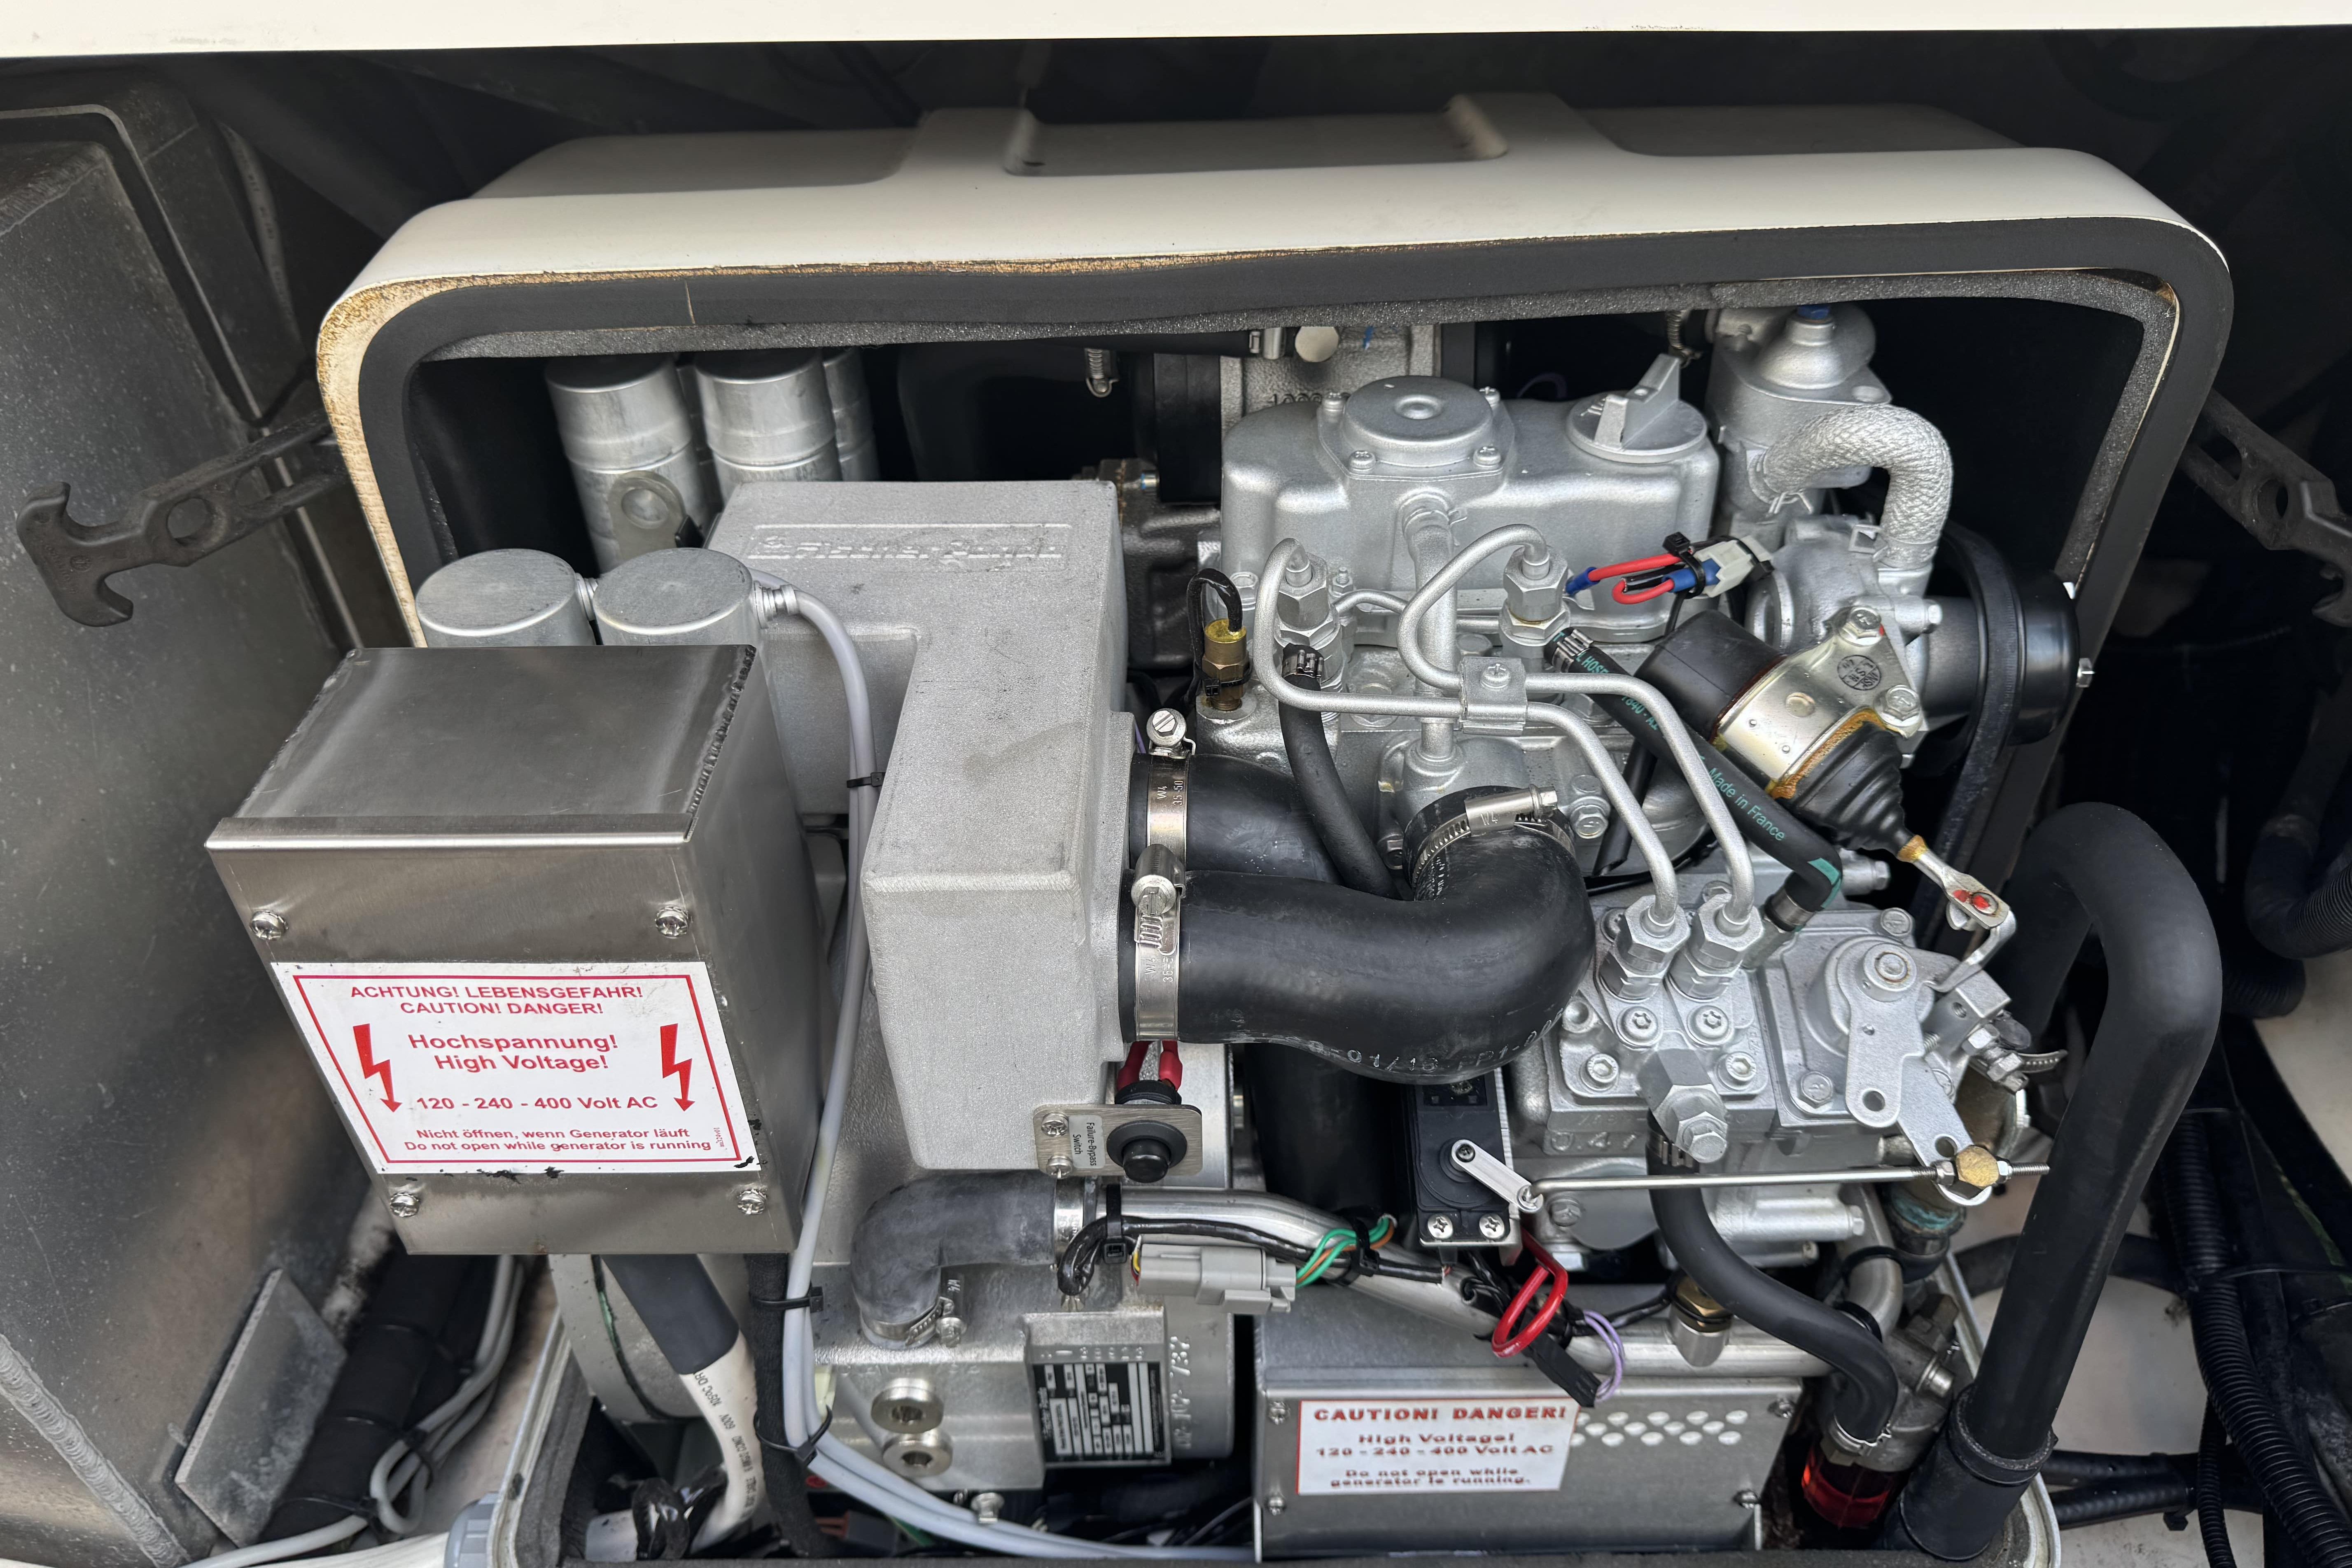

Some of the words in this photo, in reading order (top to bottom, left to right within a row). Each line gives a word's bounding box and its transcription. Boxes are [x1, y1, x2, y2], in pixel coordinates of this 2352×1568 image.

[1709, 768, 1736, 797] Made
[1734, 794, 1748, 809] in
[1747, 805, 1785, 841] France
[1480, 810, 1499, 826] W4
[351, 986, 459, 999] ACHTUNG!
[465, 986, 643, 999] LEBENSGEFAHR!
[400, 1002, 501, 1015] CAUTION!
[507, 1002, 603, 1015] DANGER!
[408, 1034, 618, 1053] Hochspannung!
[435, 1055, 497, 1072] High
[502, 1055, 609, 1072] Voltage!
[417, 1098, 455, 1110] 120
[474, 1097, 513, 1109] 240
[534, 1097, 572, 1109] 400
[577, 1096, 621, 1109] Volt
[627, 1096, 658, 1109] AC
[416, 1129, 457, 1139] Nicht
[463, 1129, 518, 1140] öffnen,
[569, 1129, 649, 1139] Generator
[654, 1129, 690, 1138] läuft
[404, 1142, 427, 1150] Do
[432, 1142, 457, 1150] not
[461, 1143, 500, 1153] open
[504, 1141, 545, 1150] while
[550, 1142, 625, 1152] generator
[632, 1141, 645, 1150] is
[650, 1141, 712, 1152] running
[1072, 1134, 1081, 1155] Switch
[1086, 1122, 1097, 1166] Failure-Bypass
[1314, 1407, 1439, 1421] CAUTION!
[1453, 1406, 1566, 1420] DANGER!
[1358, 1434, 1411, 1444] High
[1419, 1433, 1515, 1444] Voltage!
[1316, 1448, 1352, 1456] 120
[1373, 1447, 1410, 1456] 240
[1432, 1446, 1468, 1455] 400
[1474, 1445, 1519, 1455] Volt
[1522, 1445, 1554, 1454] AC
[1416, 1469, 1461, 1478] open
[1330, 1478, 1421, 1487] generator
